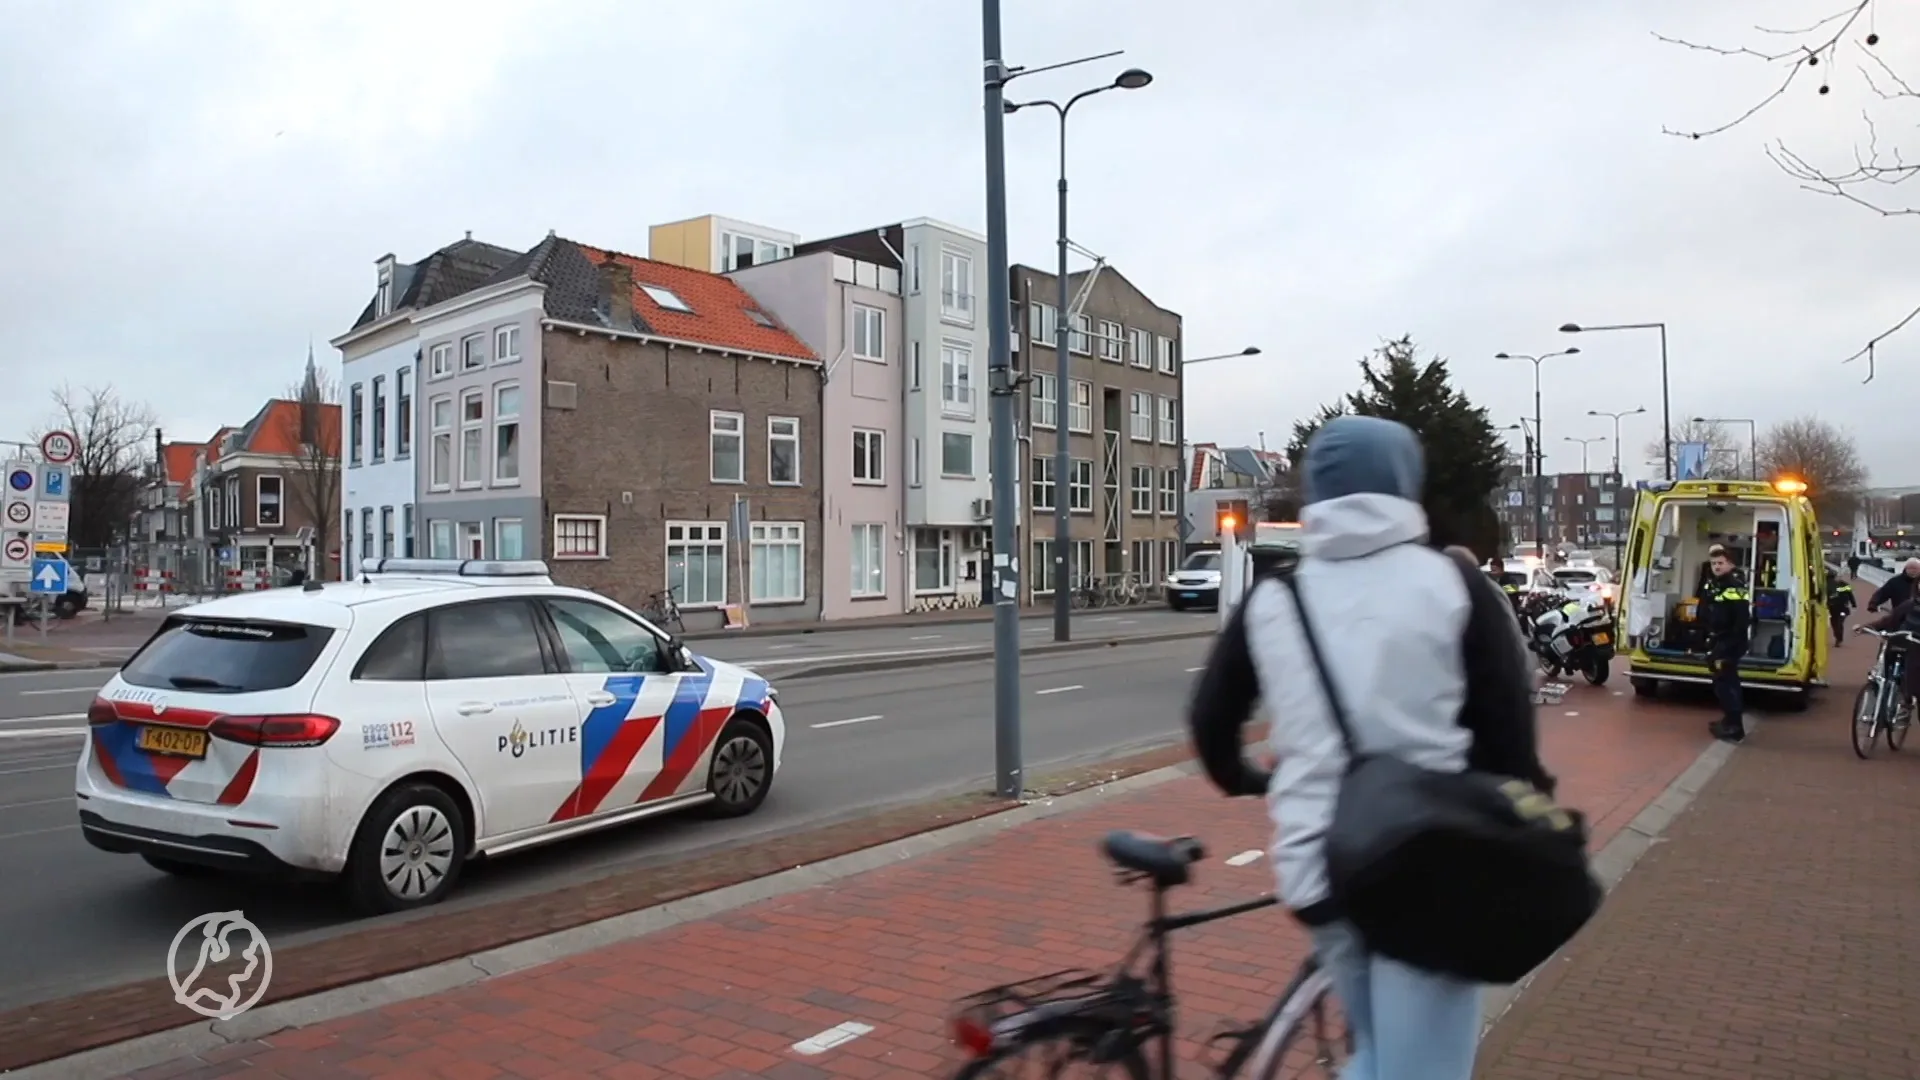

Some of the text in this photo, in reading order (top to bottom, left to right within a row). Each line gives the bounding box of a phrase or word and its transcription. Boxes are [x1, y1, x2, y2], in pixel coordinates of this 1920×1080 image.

[12, 507, 27, 517] 30
[390, 721, 414, 736] 112
[498, 726, 577, 758] POLITIE
